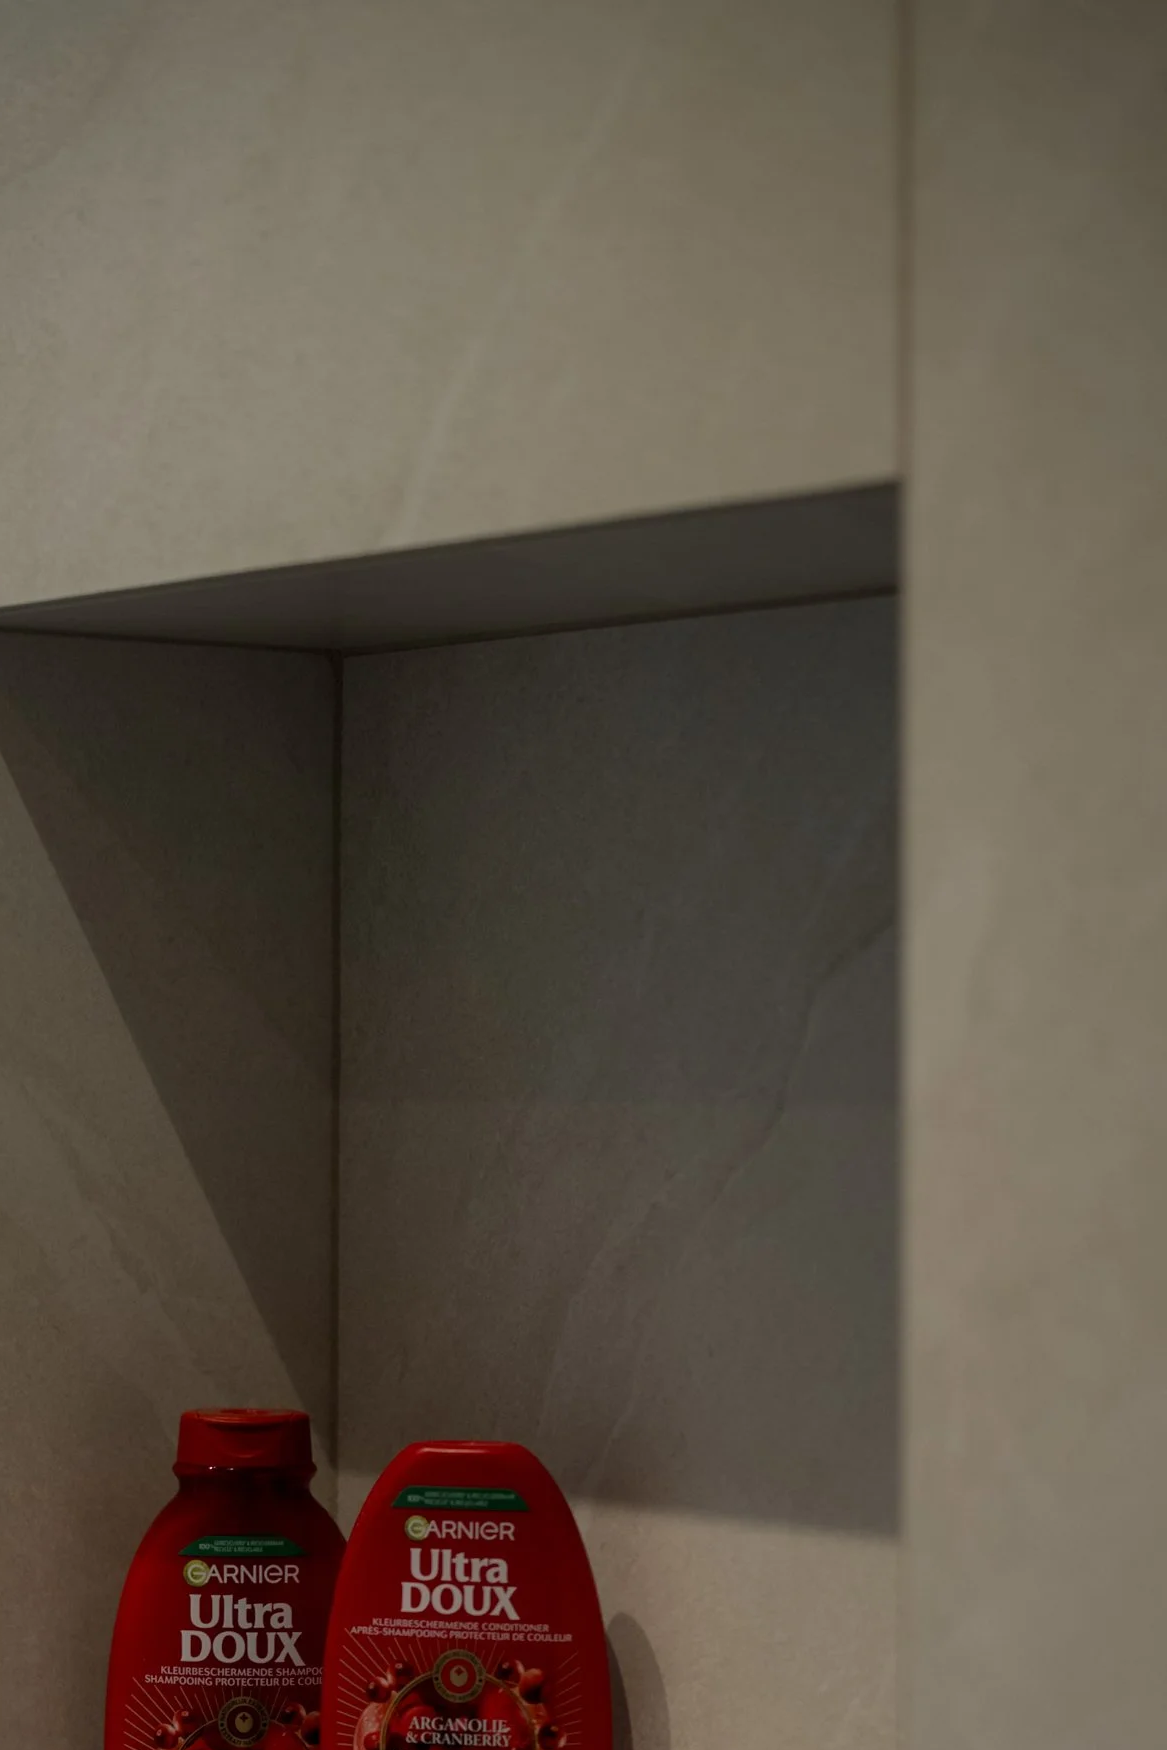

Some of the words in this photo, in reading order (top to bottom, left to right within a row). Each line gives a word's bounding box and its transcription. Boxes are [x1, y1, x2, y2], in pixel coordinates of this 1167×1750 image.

[406, 1518, 515, 1541] GARNIER
[184, 1563, 300, 1584] GARNIER
[410, 1548, 509, 1583] Ultra
[400, 1582, 521, 1620] DOUX
[189, 1593, 293, 1629] Ultra
[372, 1618, 479, 1631] KLEURBESCHERMENDE
[481, 1622, 549, 1633] CONDITIONER
[449, 1631, 510, 1642] PROTECTEUR
[512, 1632, 526, 1642] DE
[527, 1633, 572, 1643] COULEUR
[180, 1629, 306, 1667] DOUX
[144, 1674, 213, 1686] SHAMPOOING
[215, 1676, 280, 1687] PROTECTEUR
[282, 1677, 295, 1686] DE
[160, 1665, 273, 1677] KLEURBESCHERMENDE
[409, 1716, 510, 1733] ARGANOLIE
[405, 1731, 418, 1744] &
[420, 1732, 512, 1748] CRANBERRY
